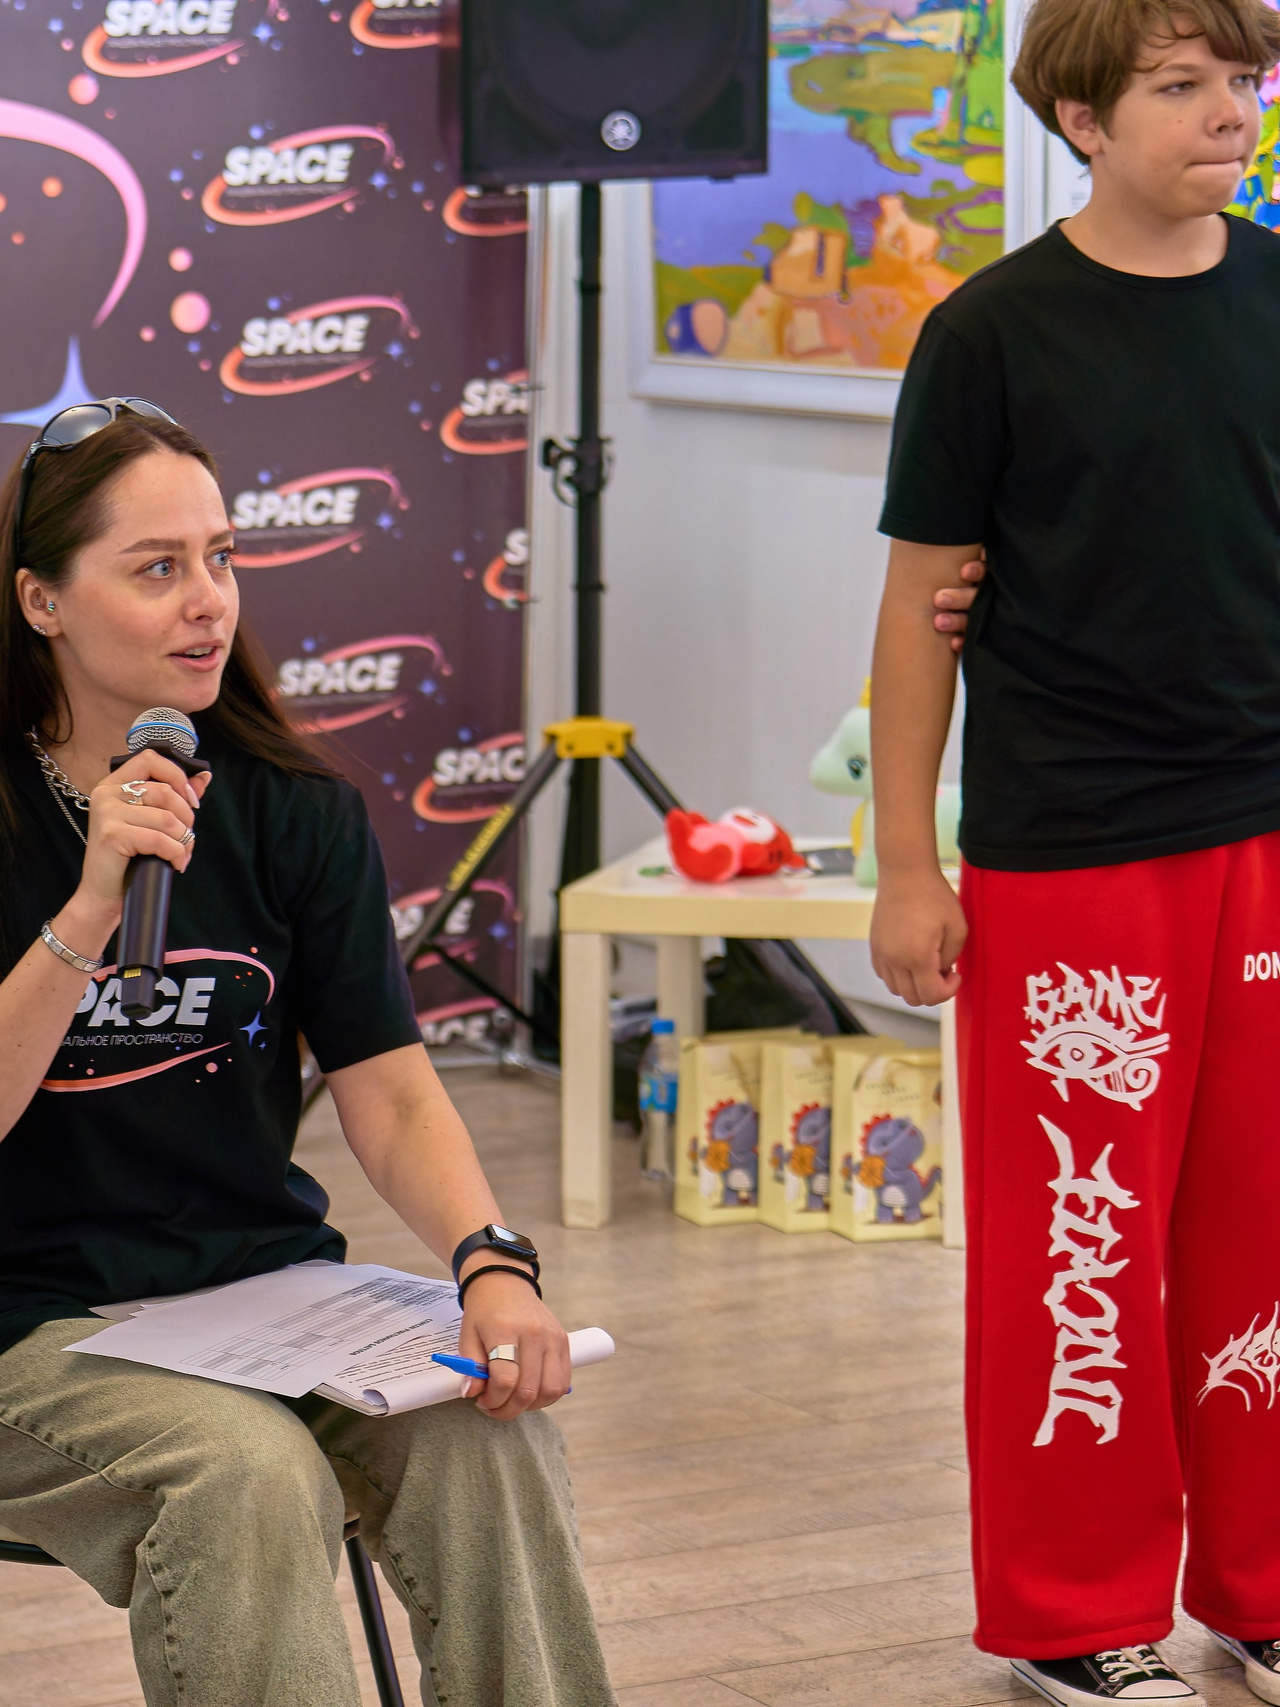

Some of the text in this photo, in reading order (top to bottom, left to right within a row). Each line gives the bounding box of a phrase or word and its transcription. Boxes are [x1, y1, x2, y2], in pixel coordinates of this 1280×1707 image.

[104, 0, 237, 36] SPACE
[222, 143, 355, 187] SPACE
[240, 314, 370, 358] SPACE
[231, 486, 360, 529] SPACE
[277, 653, 404, 697] SPACE
[110, 1032, 204, 1047] ПРОСТРАНСТВО
